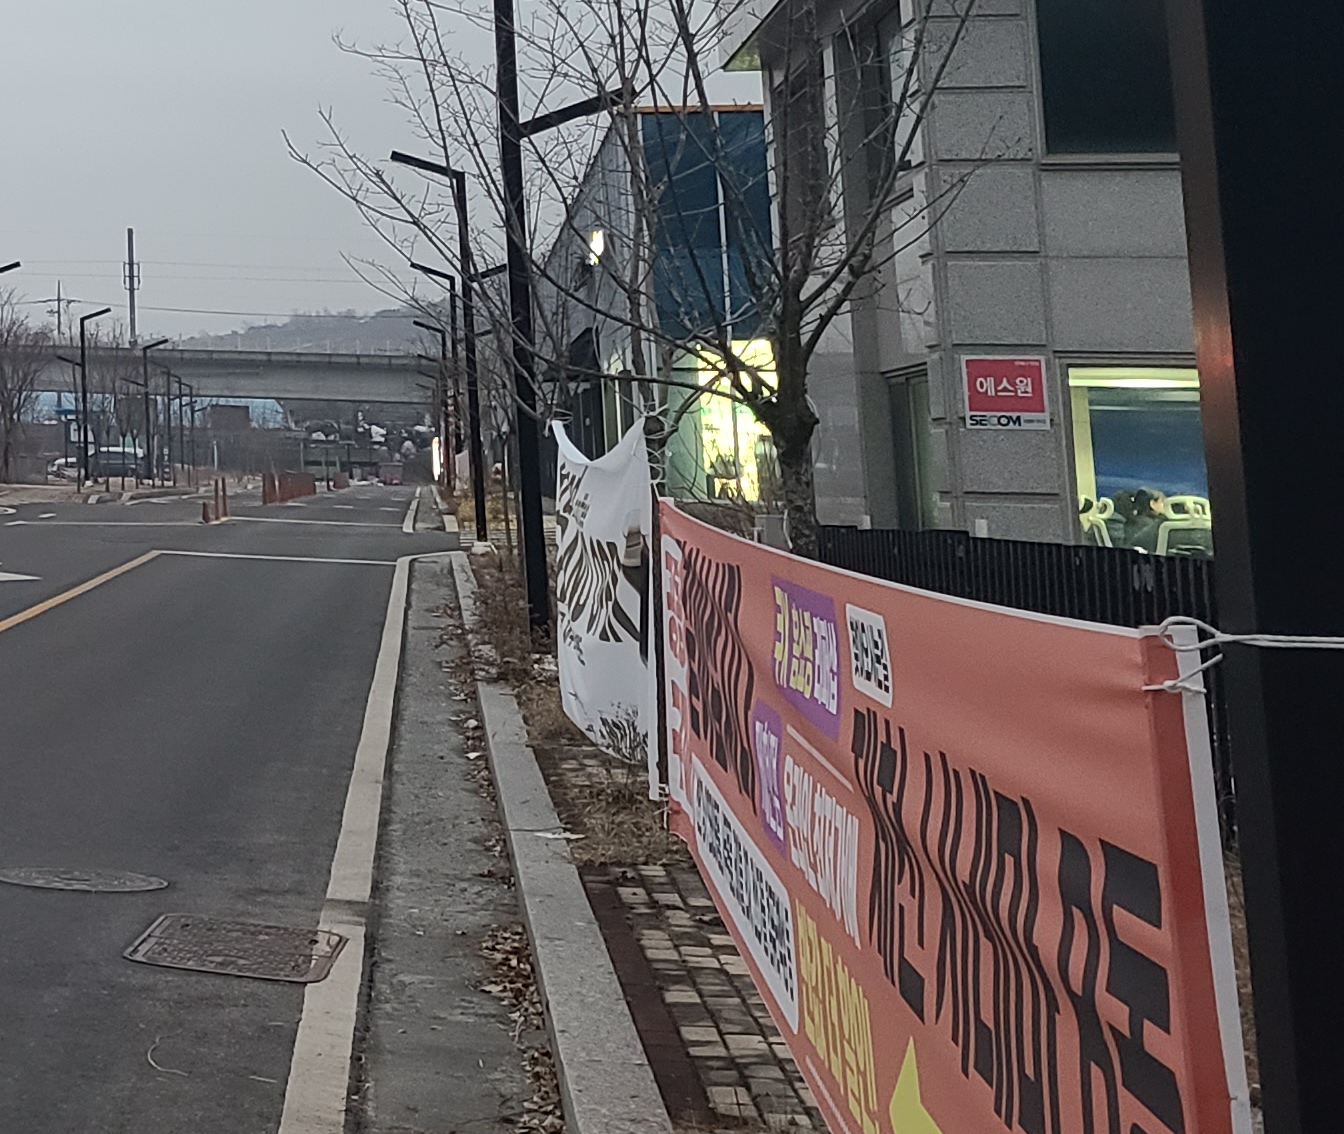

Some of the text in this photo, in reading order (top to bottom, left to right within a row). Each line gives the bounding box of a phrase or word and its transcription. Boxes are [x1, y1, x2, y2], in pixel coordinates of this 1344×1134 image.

[976, 376, 1033, 397] 에스원
[969, 414, 1022, 427] SECOM
[851, 707, 925, 1025] 제천
[920, 750, 1060, 1134] 시네마
